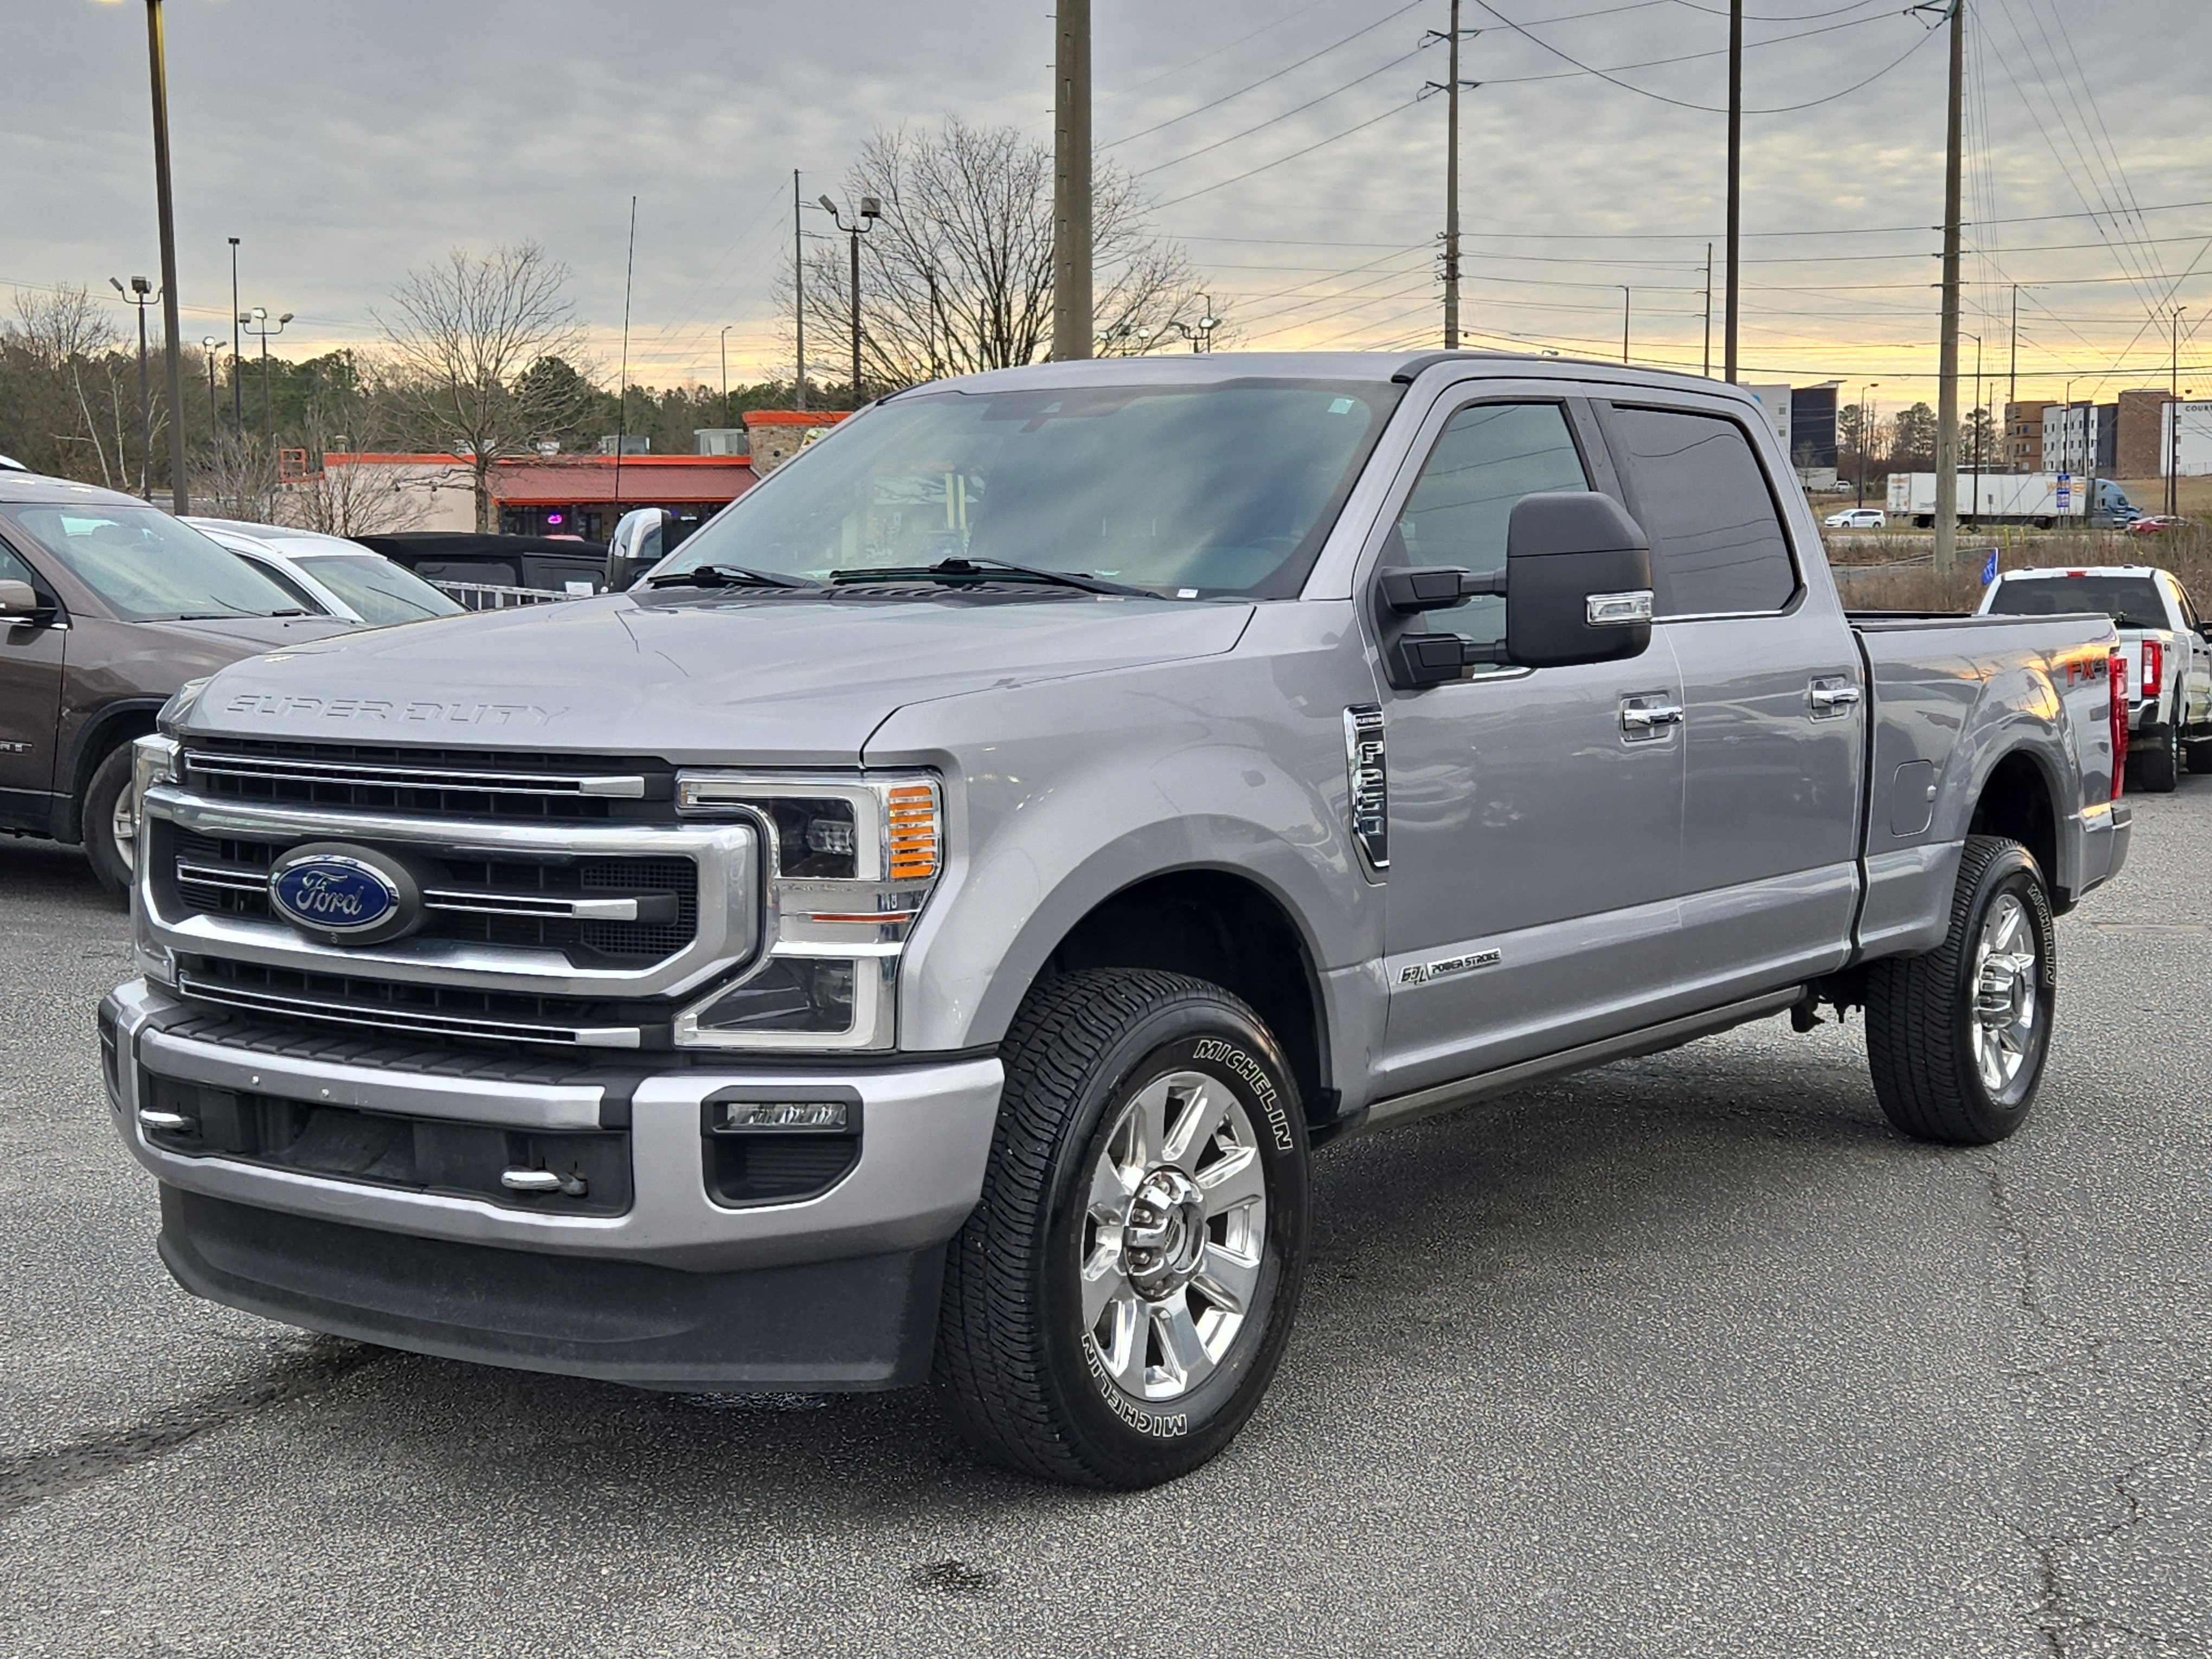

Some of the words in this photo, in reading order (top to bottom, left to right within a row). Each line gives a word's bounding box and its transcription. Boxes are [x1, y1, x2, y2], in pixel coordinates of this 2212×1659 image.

[2066, 655, 2107, 687] FX4
[224, 695, 394, 719] SUPER
[398, 701, 570, 726] DUTY
[295, 870, 365, 916] Ford
[2027, 883, 2055, 985] MICHELIN
[1431, 959, 1464, 974] POWER
[1464, 950, 1501, 967] STROKE
[1193, 1039, 1294, 1150] MICHELIN
[1081, 1333, 1187, 1437] MICHELIN
